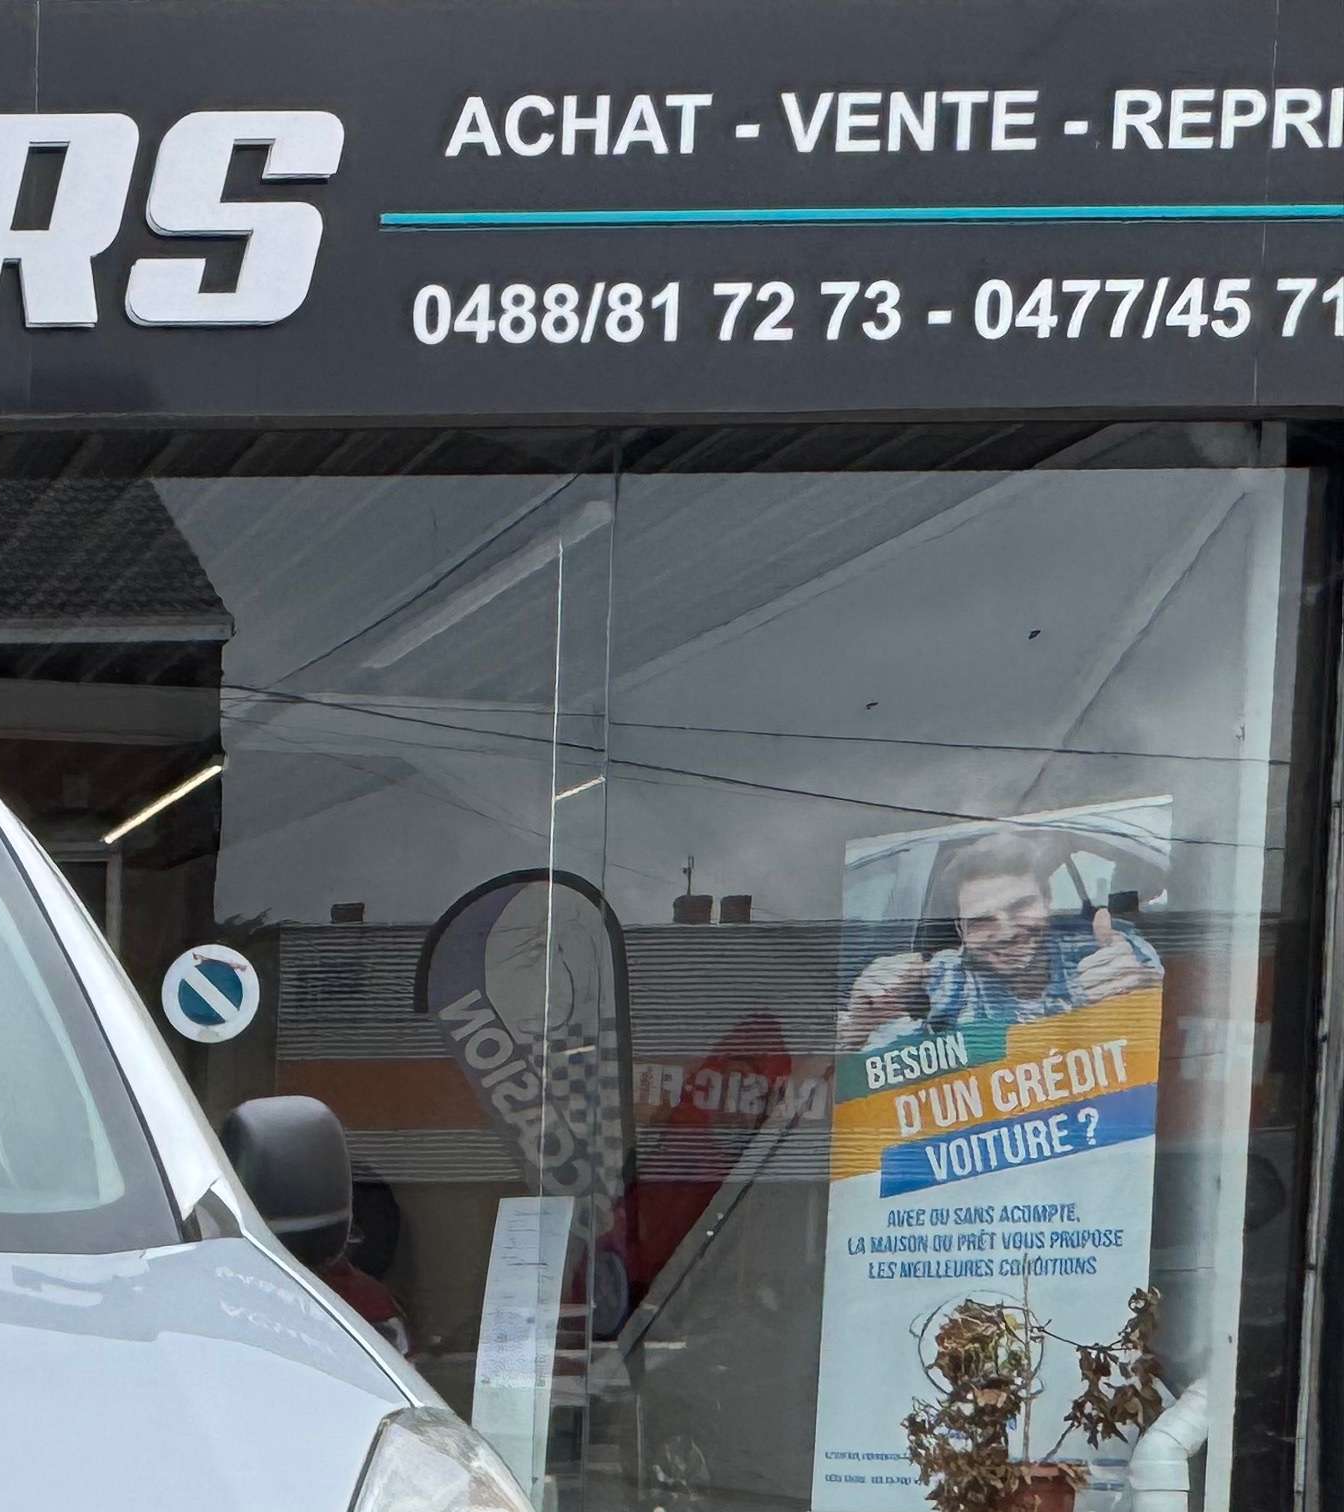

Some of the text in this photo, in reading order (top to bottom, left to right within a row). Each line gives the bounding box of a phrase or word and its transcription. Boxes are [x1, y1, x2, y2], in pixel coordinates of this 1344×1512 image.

[445, 93, 713, 157] ACHAT
[781, 89, 1040, 154] VENTE
[1111, 87, 1344, 150] REPRI
[412, 281, 679, 346] 0488/81
[713, 280, 795, 342] 72
[820, 278, 903, 342] 73
[974, 276, 1252, 341] 0477/45
[1276, 276, 1344, 338] 71
[865, 1031, 969, 1091] BESOIN
[894, 1039, 1129, 1138] D'UN CRÉDIT
[925, 1107, 1100, 1182] VOITURE ?
[848, 1236, 866, 1255] LA
[870, 1233, 928, 1255] MAISON
[957, 1229, 997, 1251] PRÊT
[1002, 1231, 1045, 1250] VOUS
[1049, 1229, 1124, 1249] PROPOSE
[887, 1208, 925, 1228] AVEC
[930, 1208, 950, 1225] OU
[953, 1206, 995, 1225] SANS
[868, 1260, 897, 1279] LES
[899, 1258, 994, 1279] MEILLEURES
